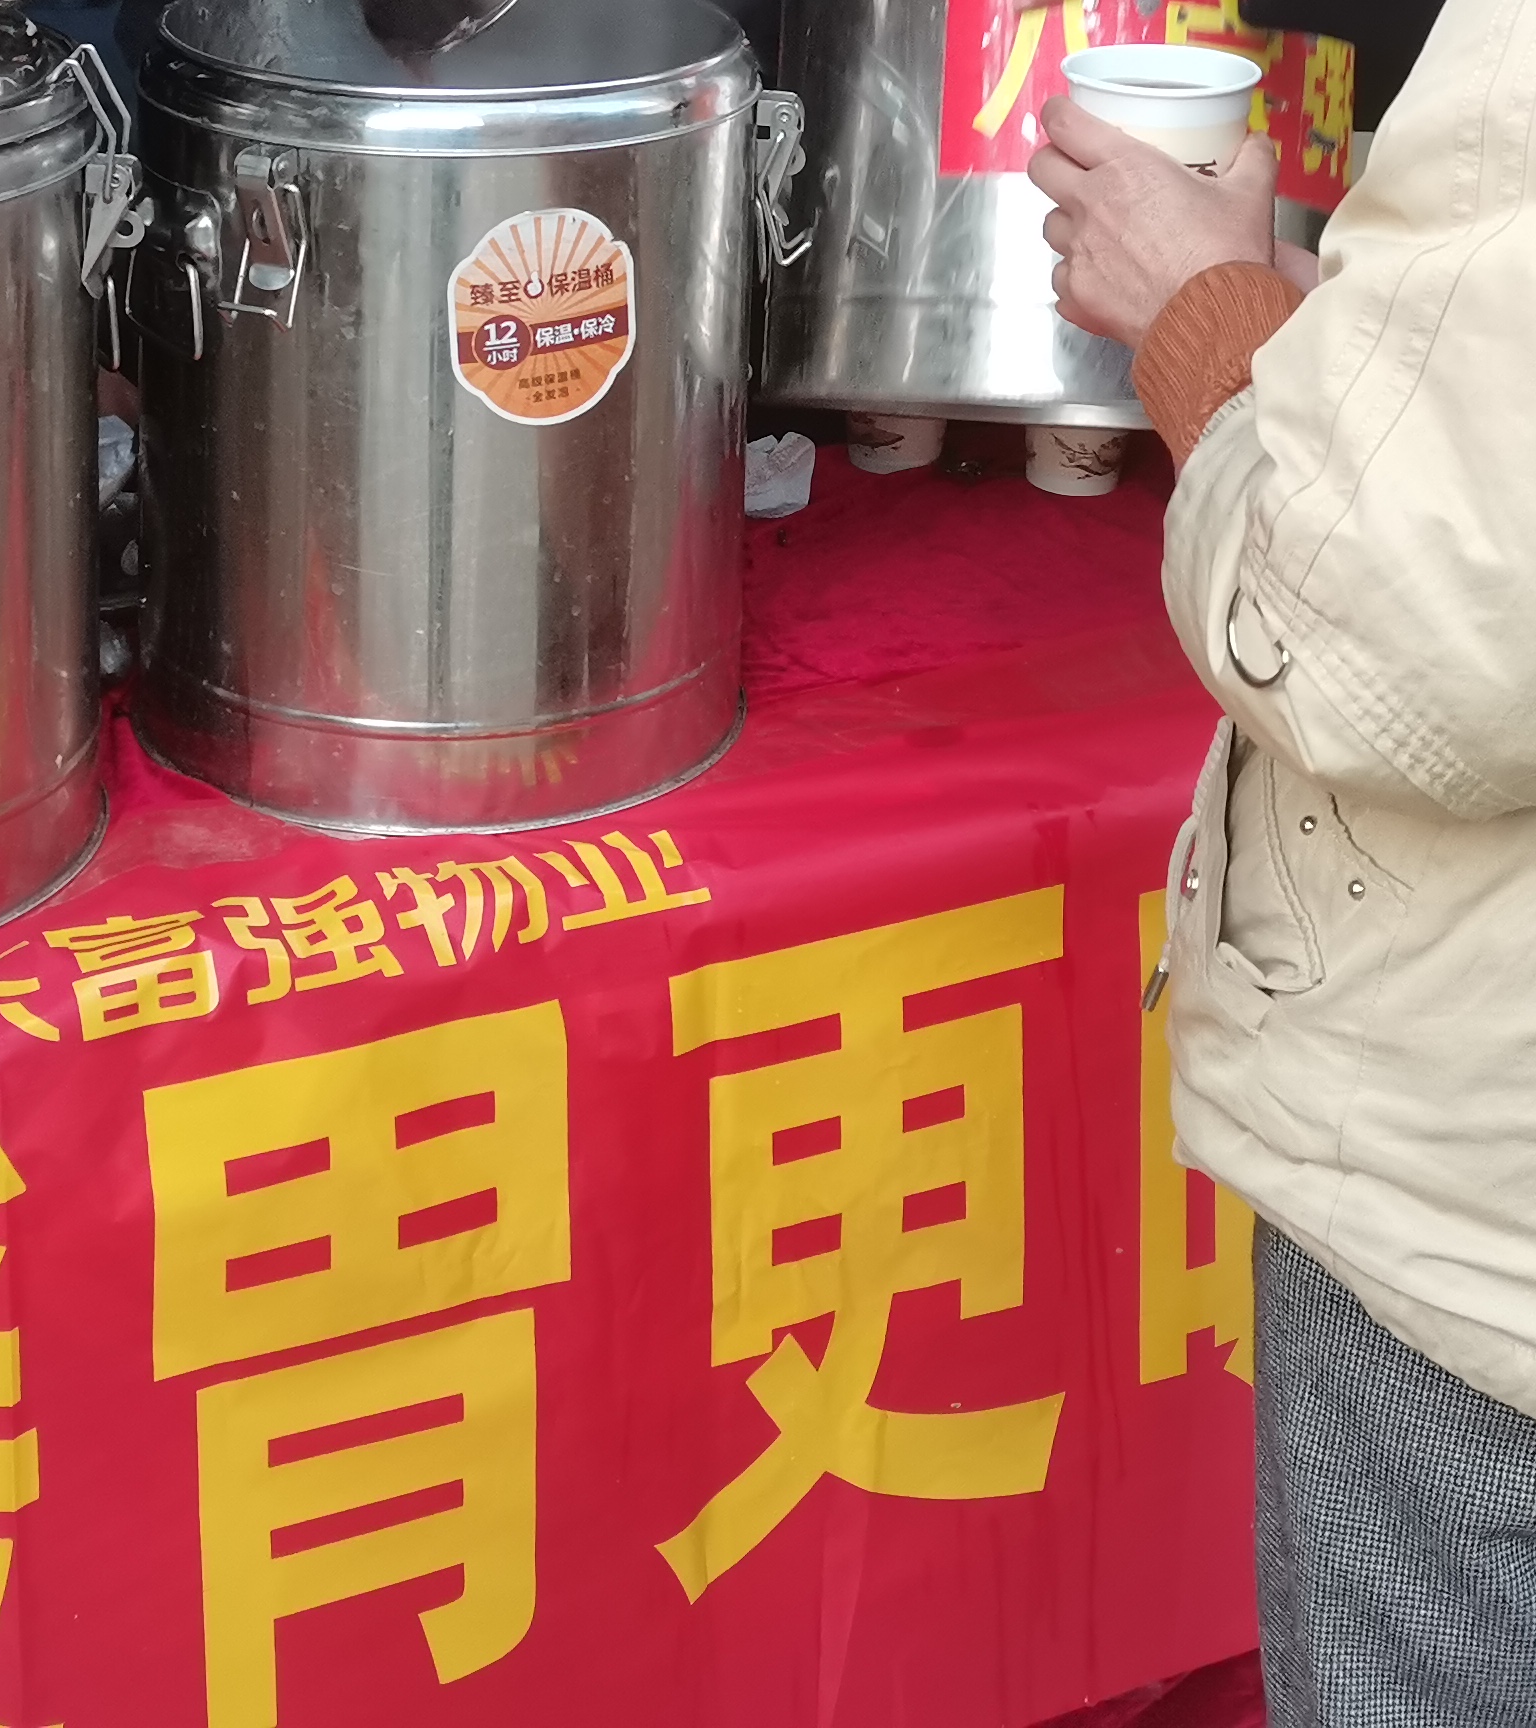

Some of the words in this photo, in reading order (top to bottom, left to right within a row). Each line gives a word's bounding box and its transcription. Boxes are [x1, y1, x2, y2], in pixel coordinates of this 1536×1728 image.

[470, 280, 522, 307] 臻至
[547, 262, 614, 298] 保温桶
[484, 321, 519, 347] 12
[486, 349, 518, 365] 小时
